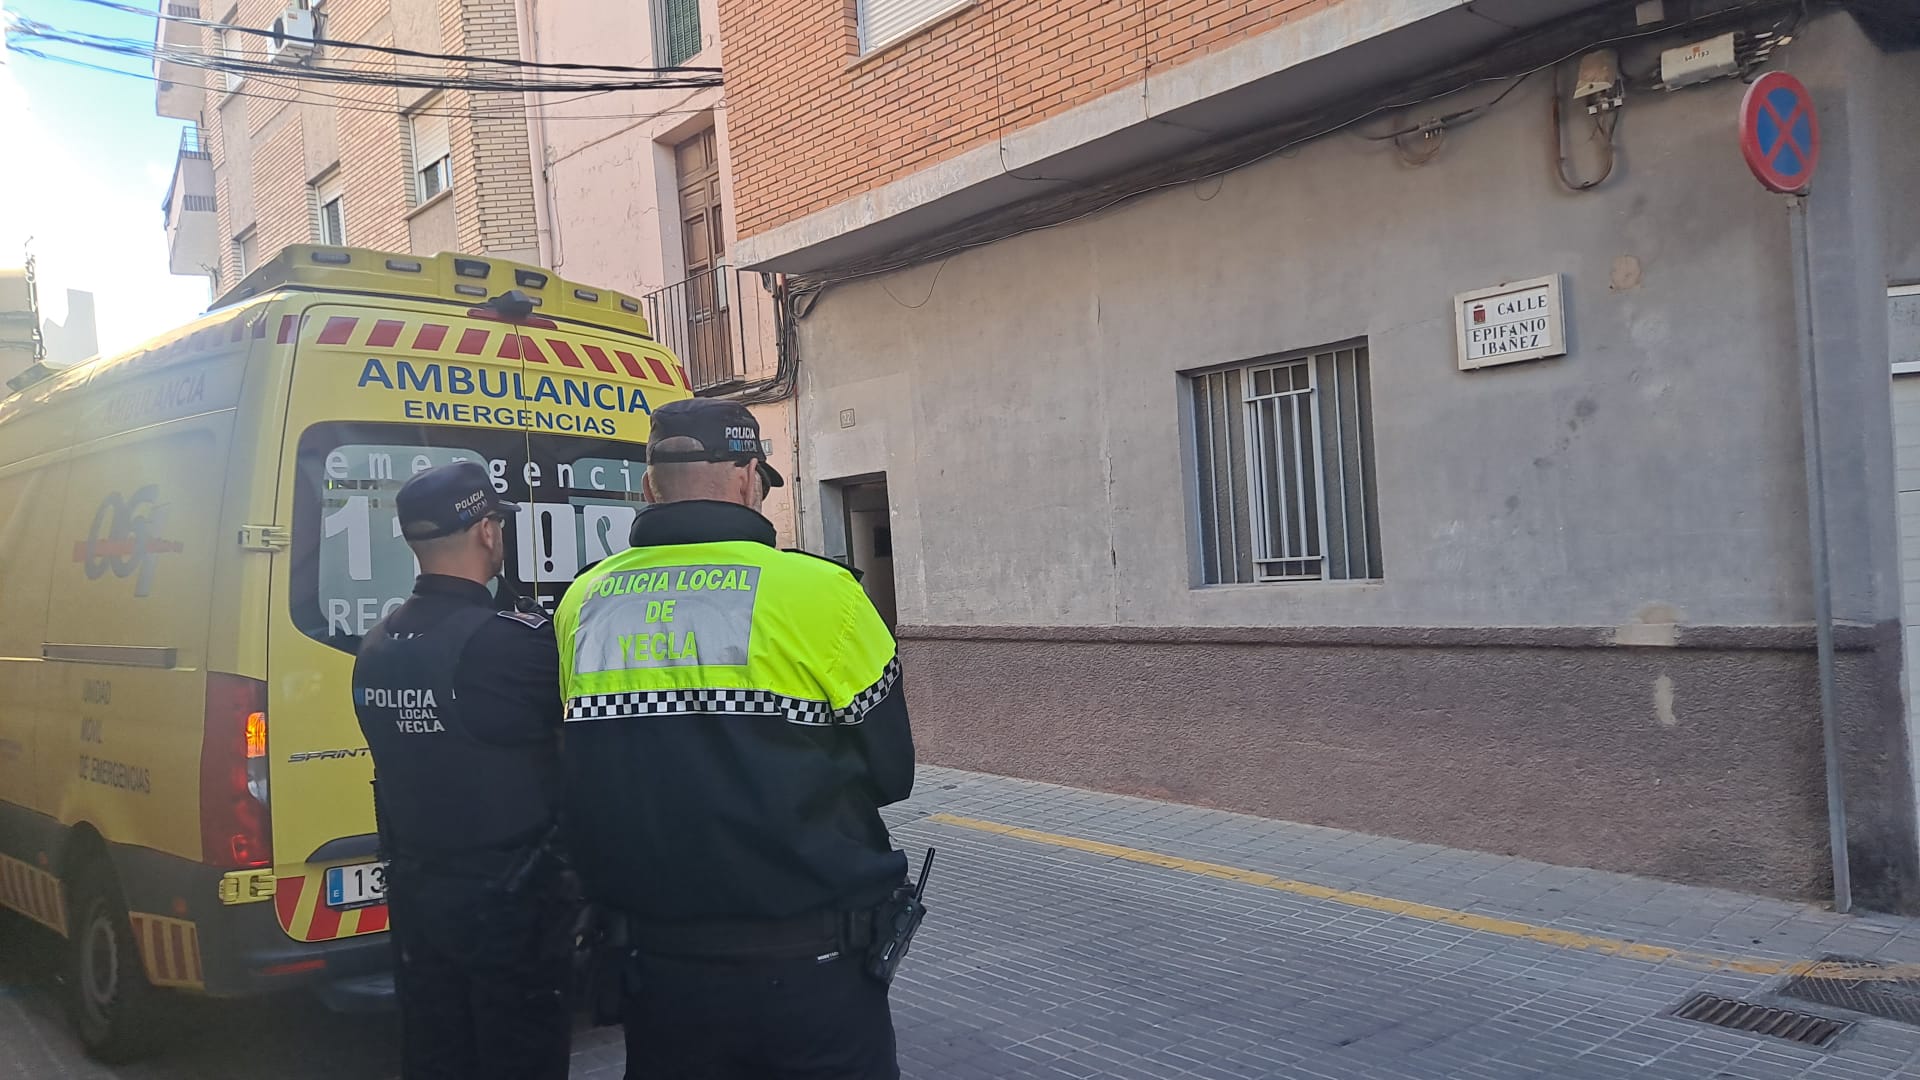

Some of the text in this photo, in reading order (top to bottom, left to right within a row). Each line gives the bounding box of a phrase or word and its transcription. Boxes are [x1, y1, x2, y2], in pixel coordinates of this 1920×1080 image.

[1497, 295, 1547, 315] CALLE
[1473, 319, 1546, 342] EPIFANIO
[1482, 335, 1540, 355] IBAÑEZ
[358, 359, 651, 415] AMBULANCIA
[404, 400, 616, 436] EMERGENCIAS
[725, 427, 756, 439] POLICIA
[454, 490, 485, 512] POLICIA
[588, 569, 752, 598] POLICIA LOCAL
[645, 600, 677, 623] DE
[618, 632, 698, 661] YECLA
[365, 688, 437, 708] POLICIA
[399, 708, 437, 719] LOCAL
[396, 720, 445, 733] YECLA
[333, 889, 340, 898] E
